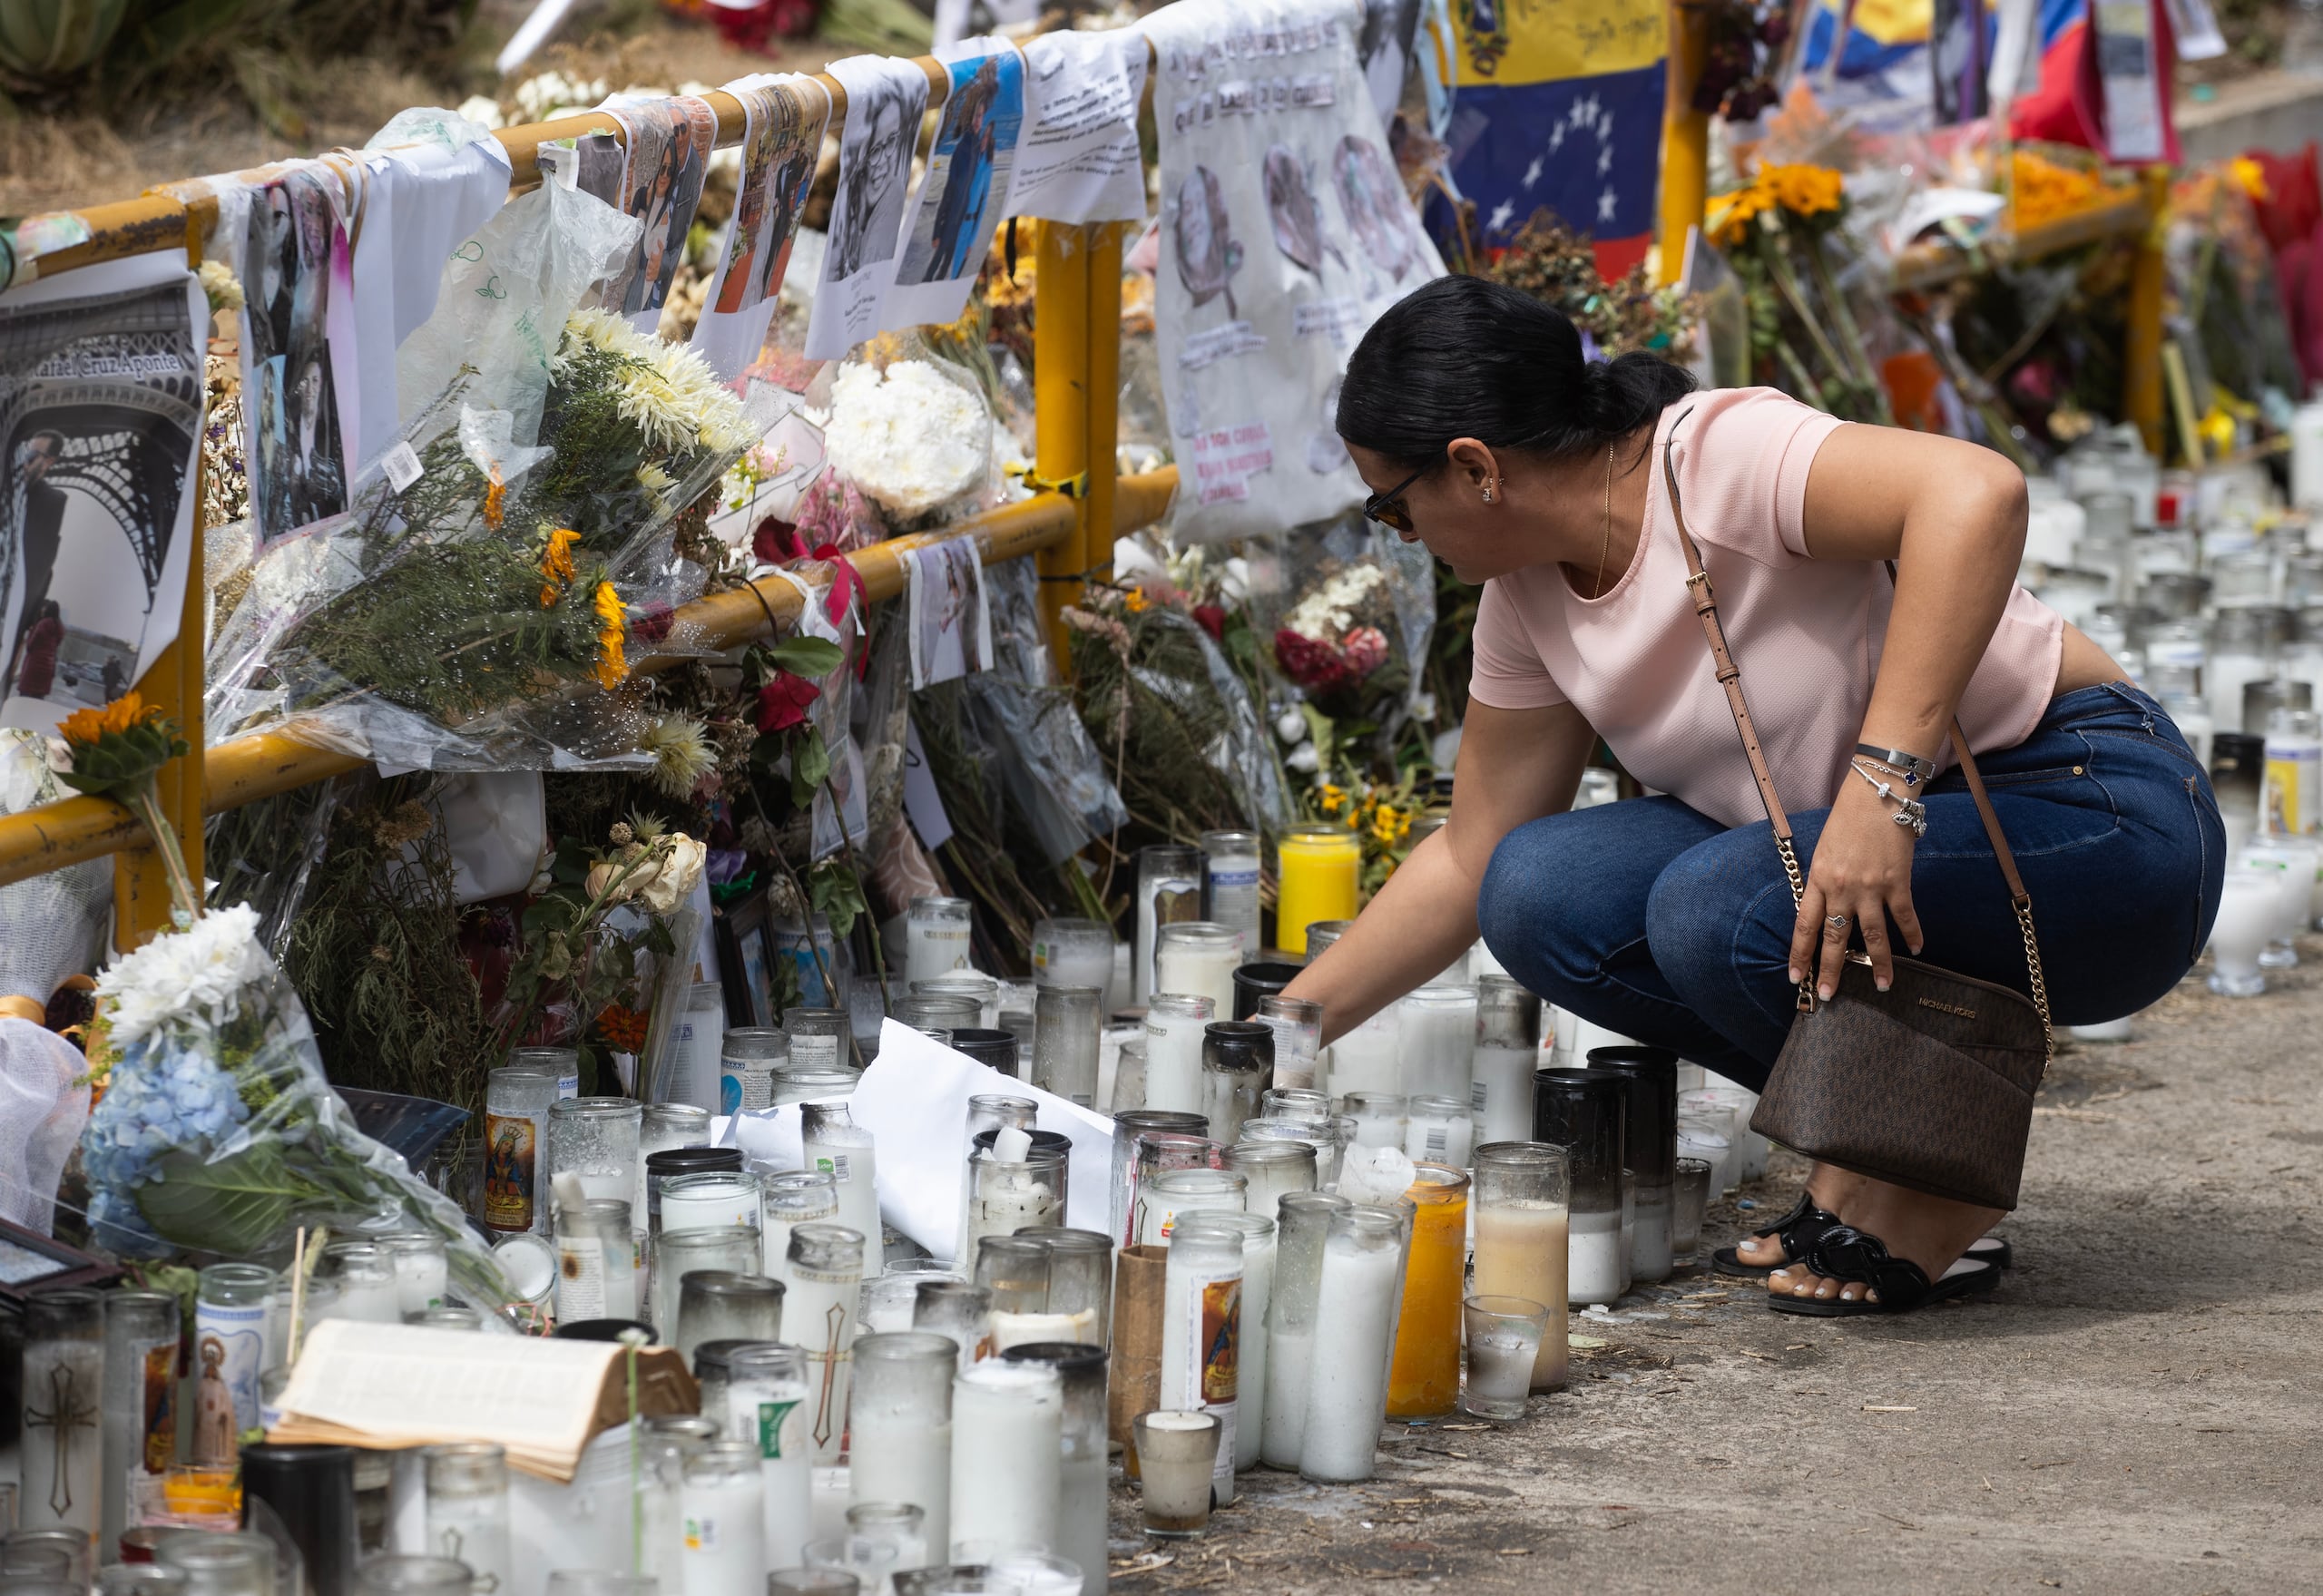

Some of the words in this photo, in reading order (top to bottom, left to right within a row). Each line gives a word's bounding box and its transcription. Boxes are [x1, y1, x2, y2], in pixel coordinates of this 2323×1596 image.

[34, 356, 78, 377] afael
[80, 354, 119, 375] Cruz
[122, 350, 178, 377] Aponte
[1918, 996, 1953, 1013] MICHAEL
[1954, 1006, 1976, 1019] KORS
